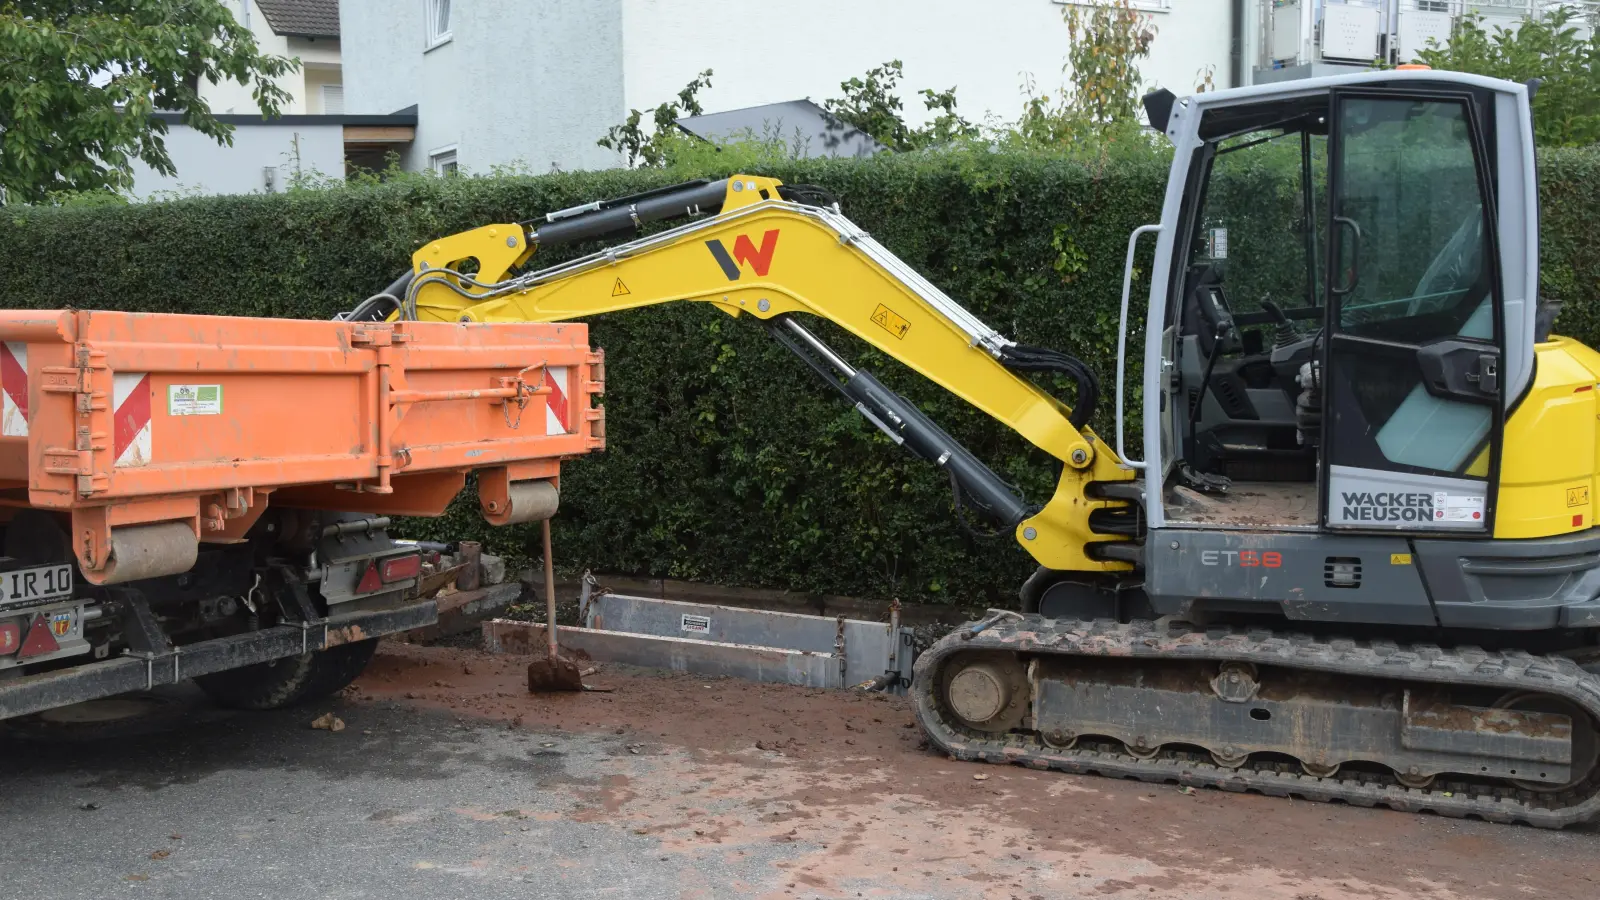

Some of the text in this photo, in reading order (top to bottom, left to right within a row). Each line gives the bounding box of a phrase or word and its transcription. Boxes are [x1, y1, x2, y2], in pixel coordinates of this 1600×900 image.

[1341, 492, 1434, 507] WACKER
[1343, 507, 1434, 522] NEUSON
[1201, 550, 1283, 568] ET58
[10, 568, 71, 599] IR 10
